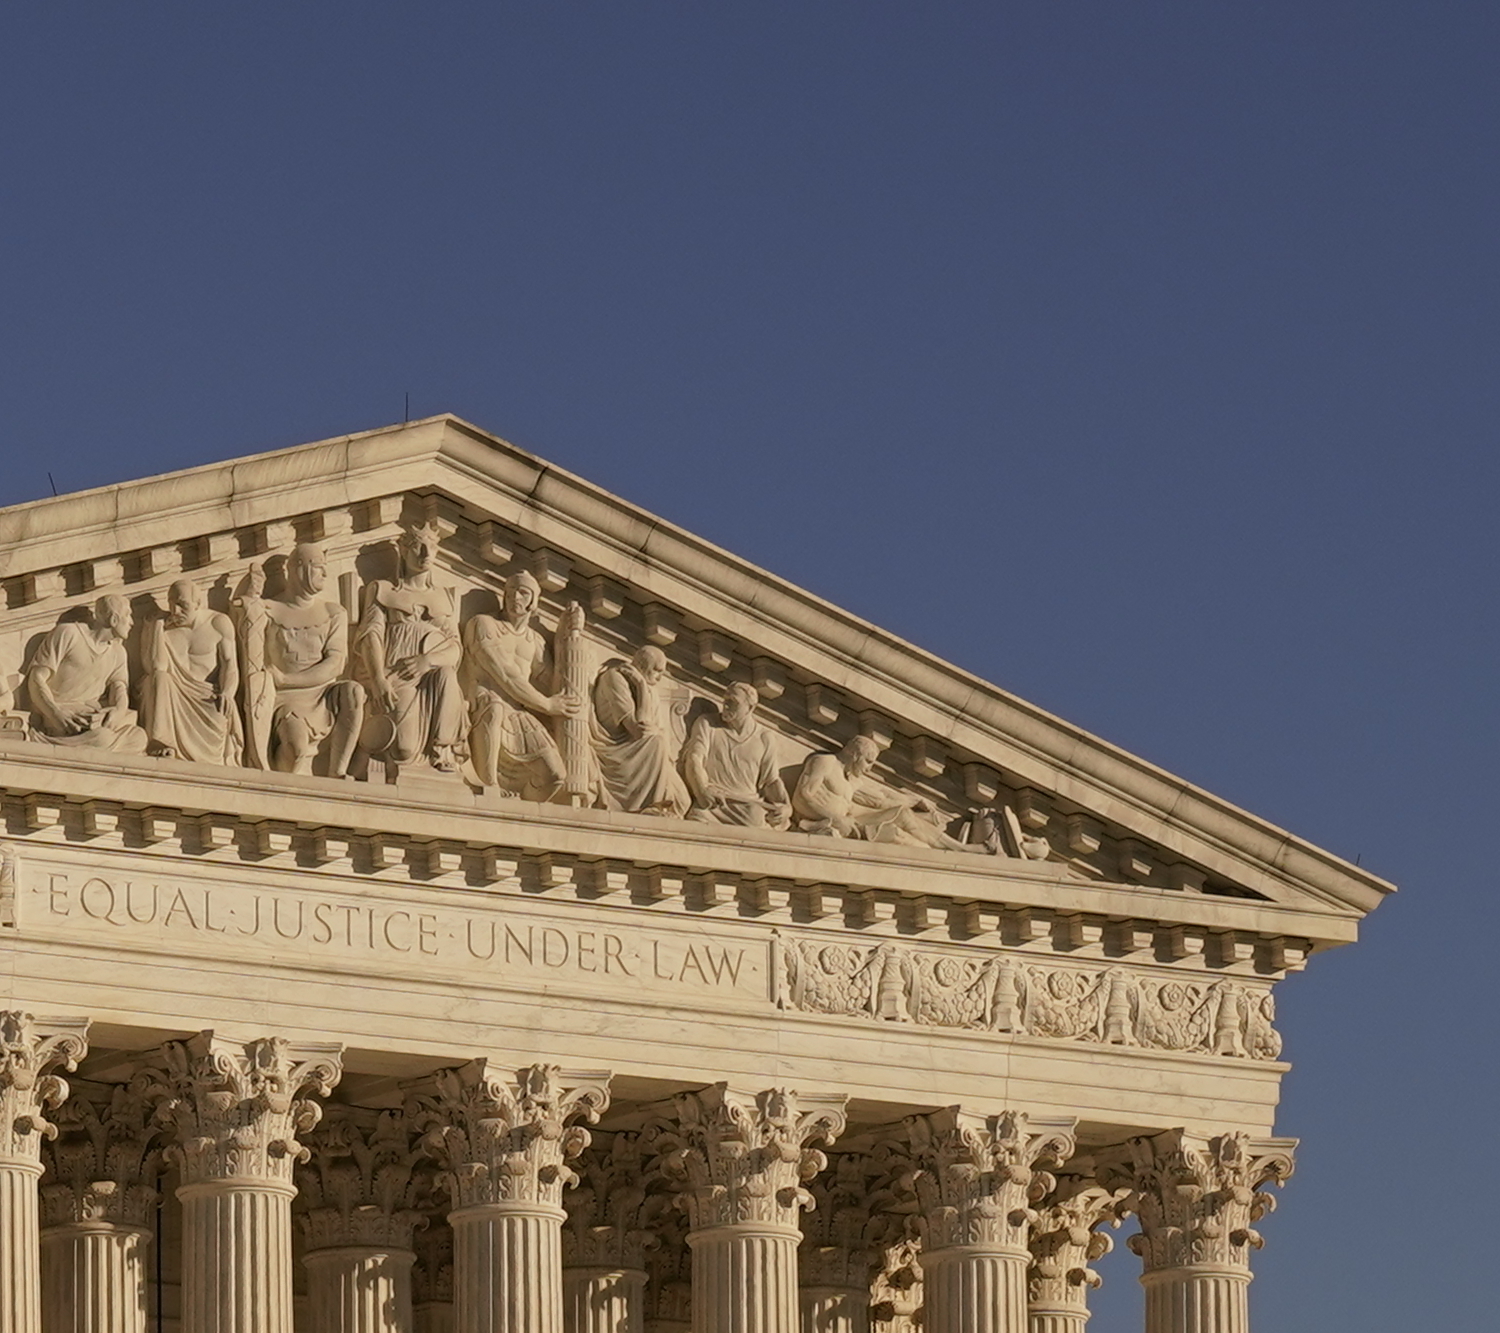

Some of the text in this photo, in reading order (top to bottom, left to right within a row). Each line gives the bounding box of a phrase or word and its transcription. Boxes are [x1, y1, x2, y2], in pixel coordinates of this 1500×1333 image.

[47, 872, 746, 987] EQUAL JUSTICE UNDER LAW
